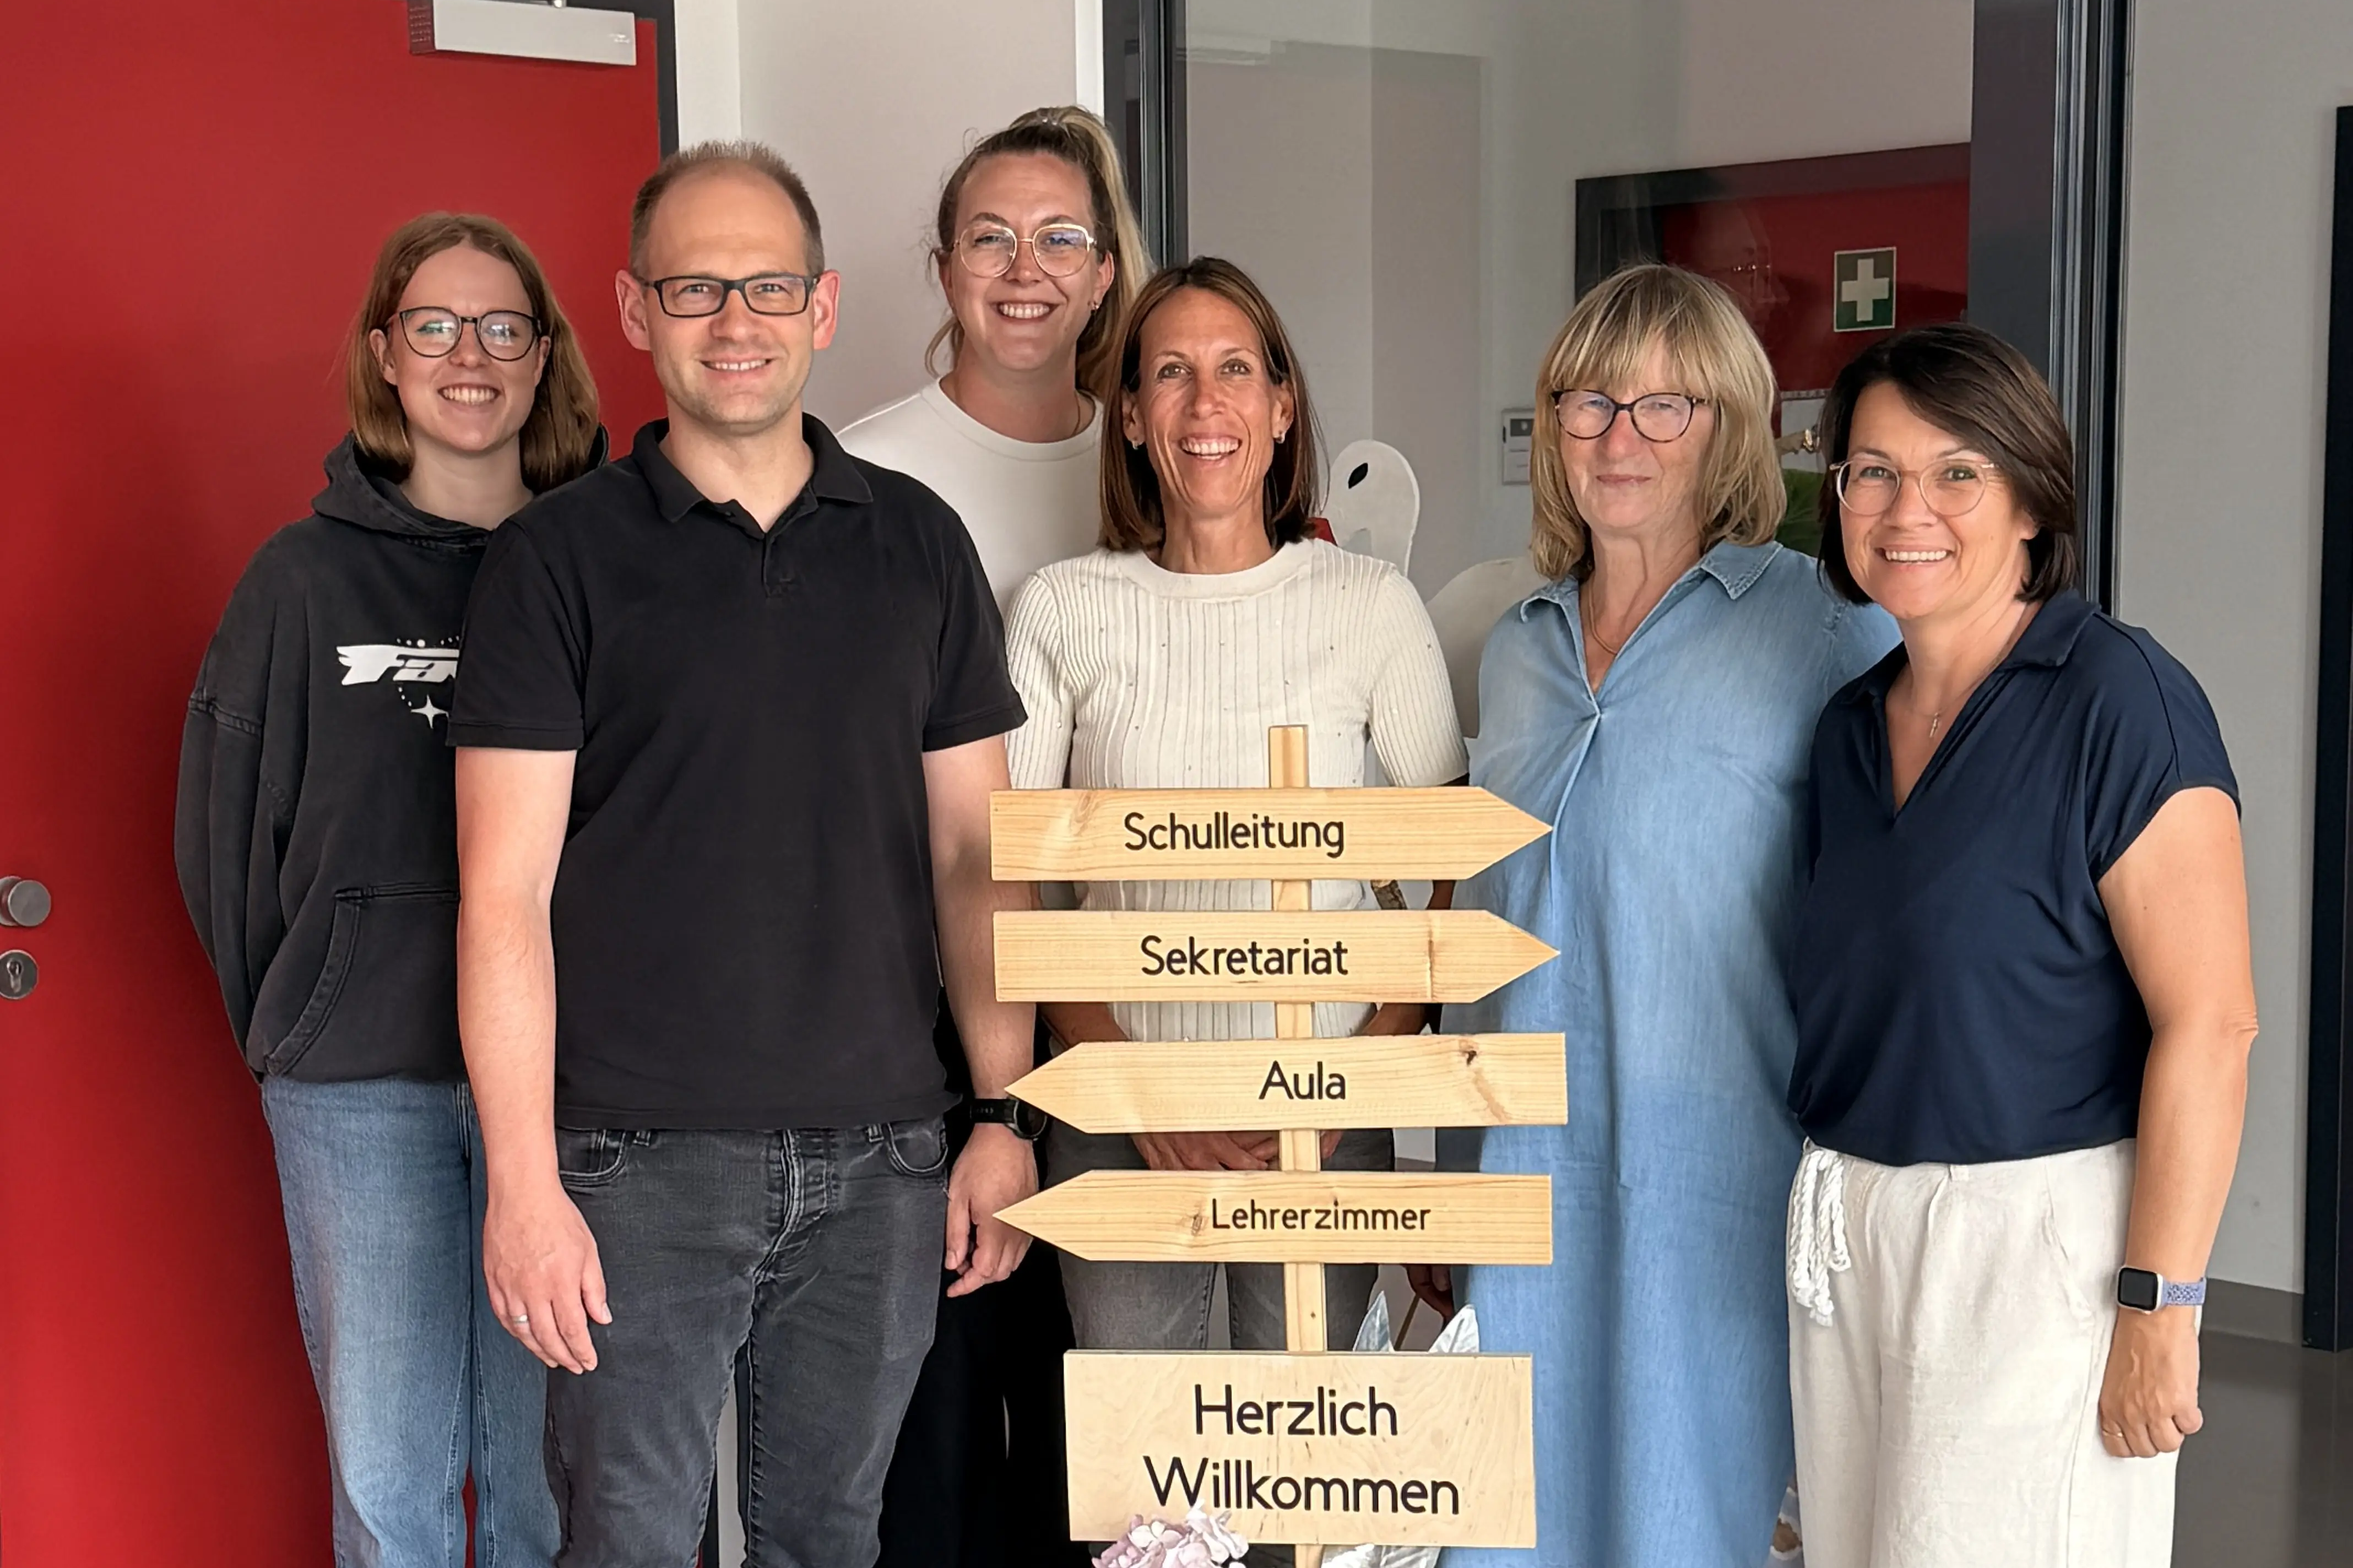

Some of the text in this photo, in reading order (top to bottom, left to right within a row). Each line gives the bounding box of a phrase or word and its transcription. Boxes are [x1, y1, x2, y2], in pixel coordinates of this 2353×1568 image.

[1124, 811, 1344, 859] Schulleitung
[1141, 935, 1348, 975] Sekretariat
[1259, 1060, 1346, 1100] Aula
[1212, 1198, 1431, 1230] Lehrerzimmer
[1194, 1383, 1398, 1436] Herzlich
[1142, 1455, 1459, 1515] Willkommen
